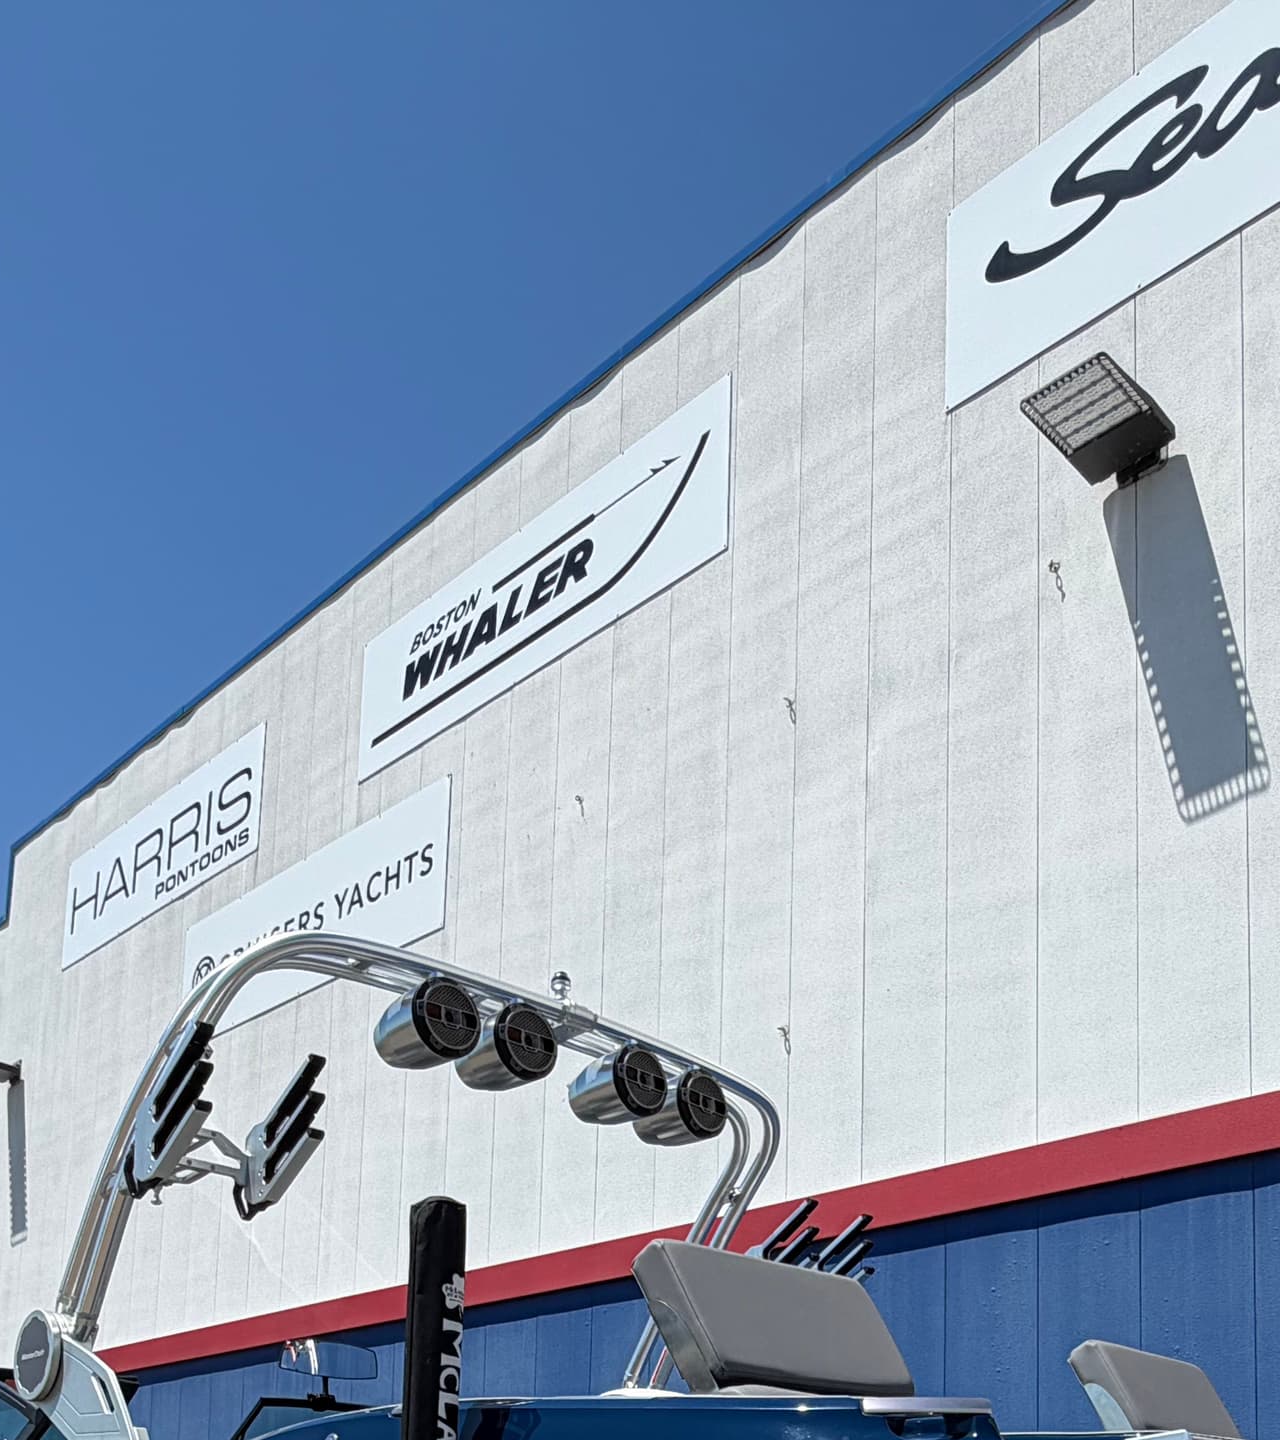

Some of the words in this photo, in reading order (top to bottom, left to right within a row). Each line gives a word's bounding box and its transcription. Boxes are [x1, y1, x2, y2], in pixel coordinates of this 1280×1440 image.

[402, 538, 594, 702] WHALER
[409, 587, 482, 655] BOSTON
[70, 767, 253, 936] HARRIS
[155, 827, 250, 901] PONTOONS
[333, 843, 434, 920] YACHTS
